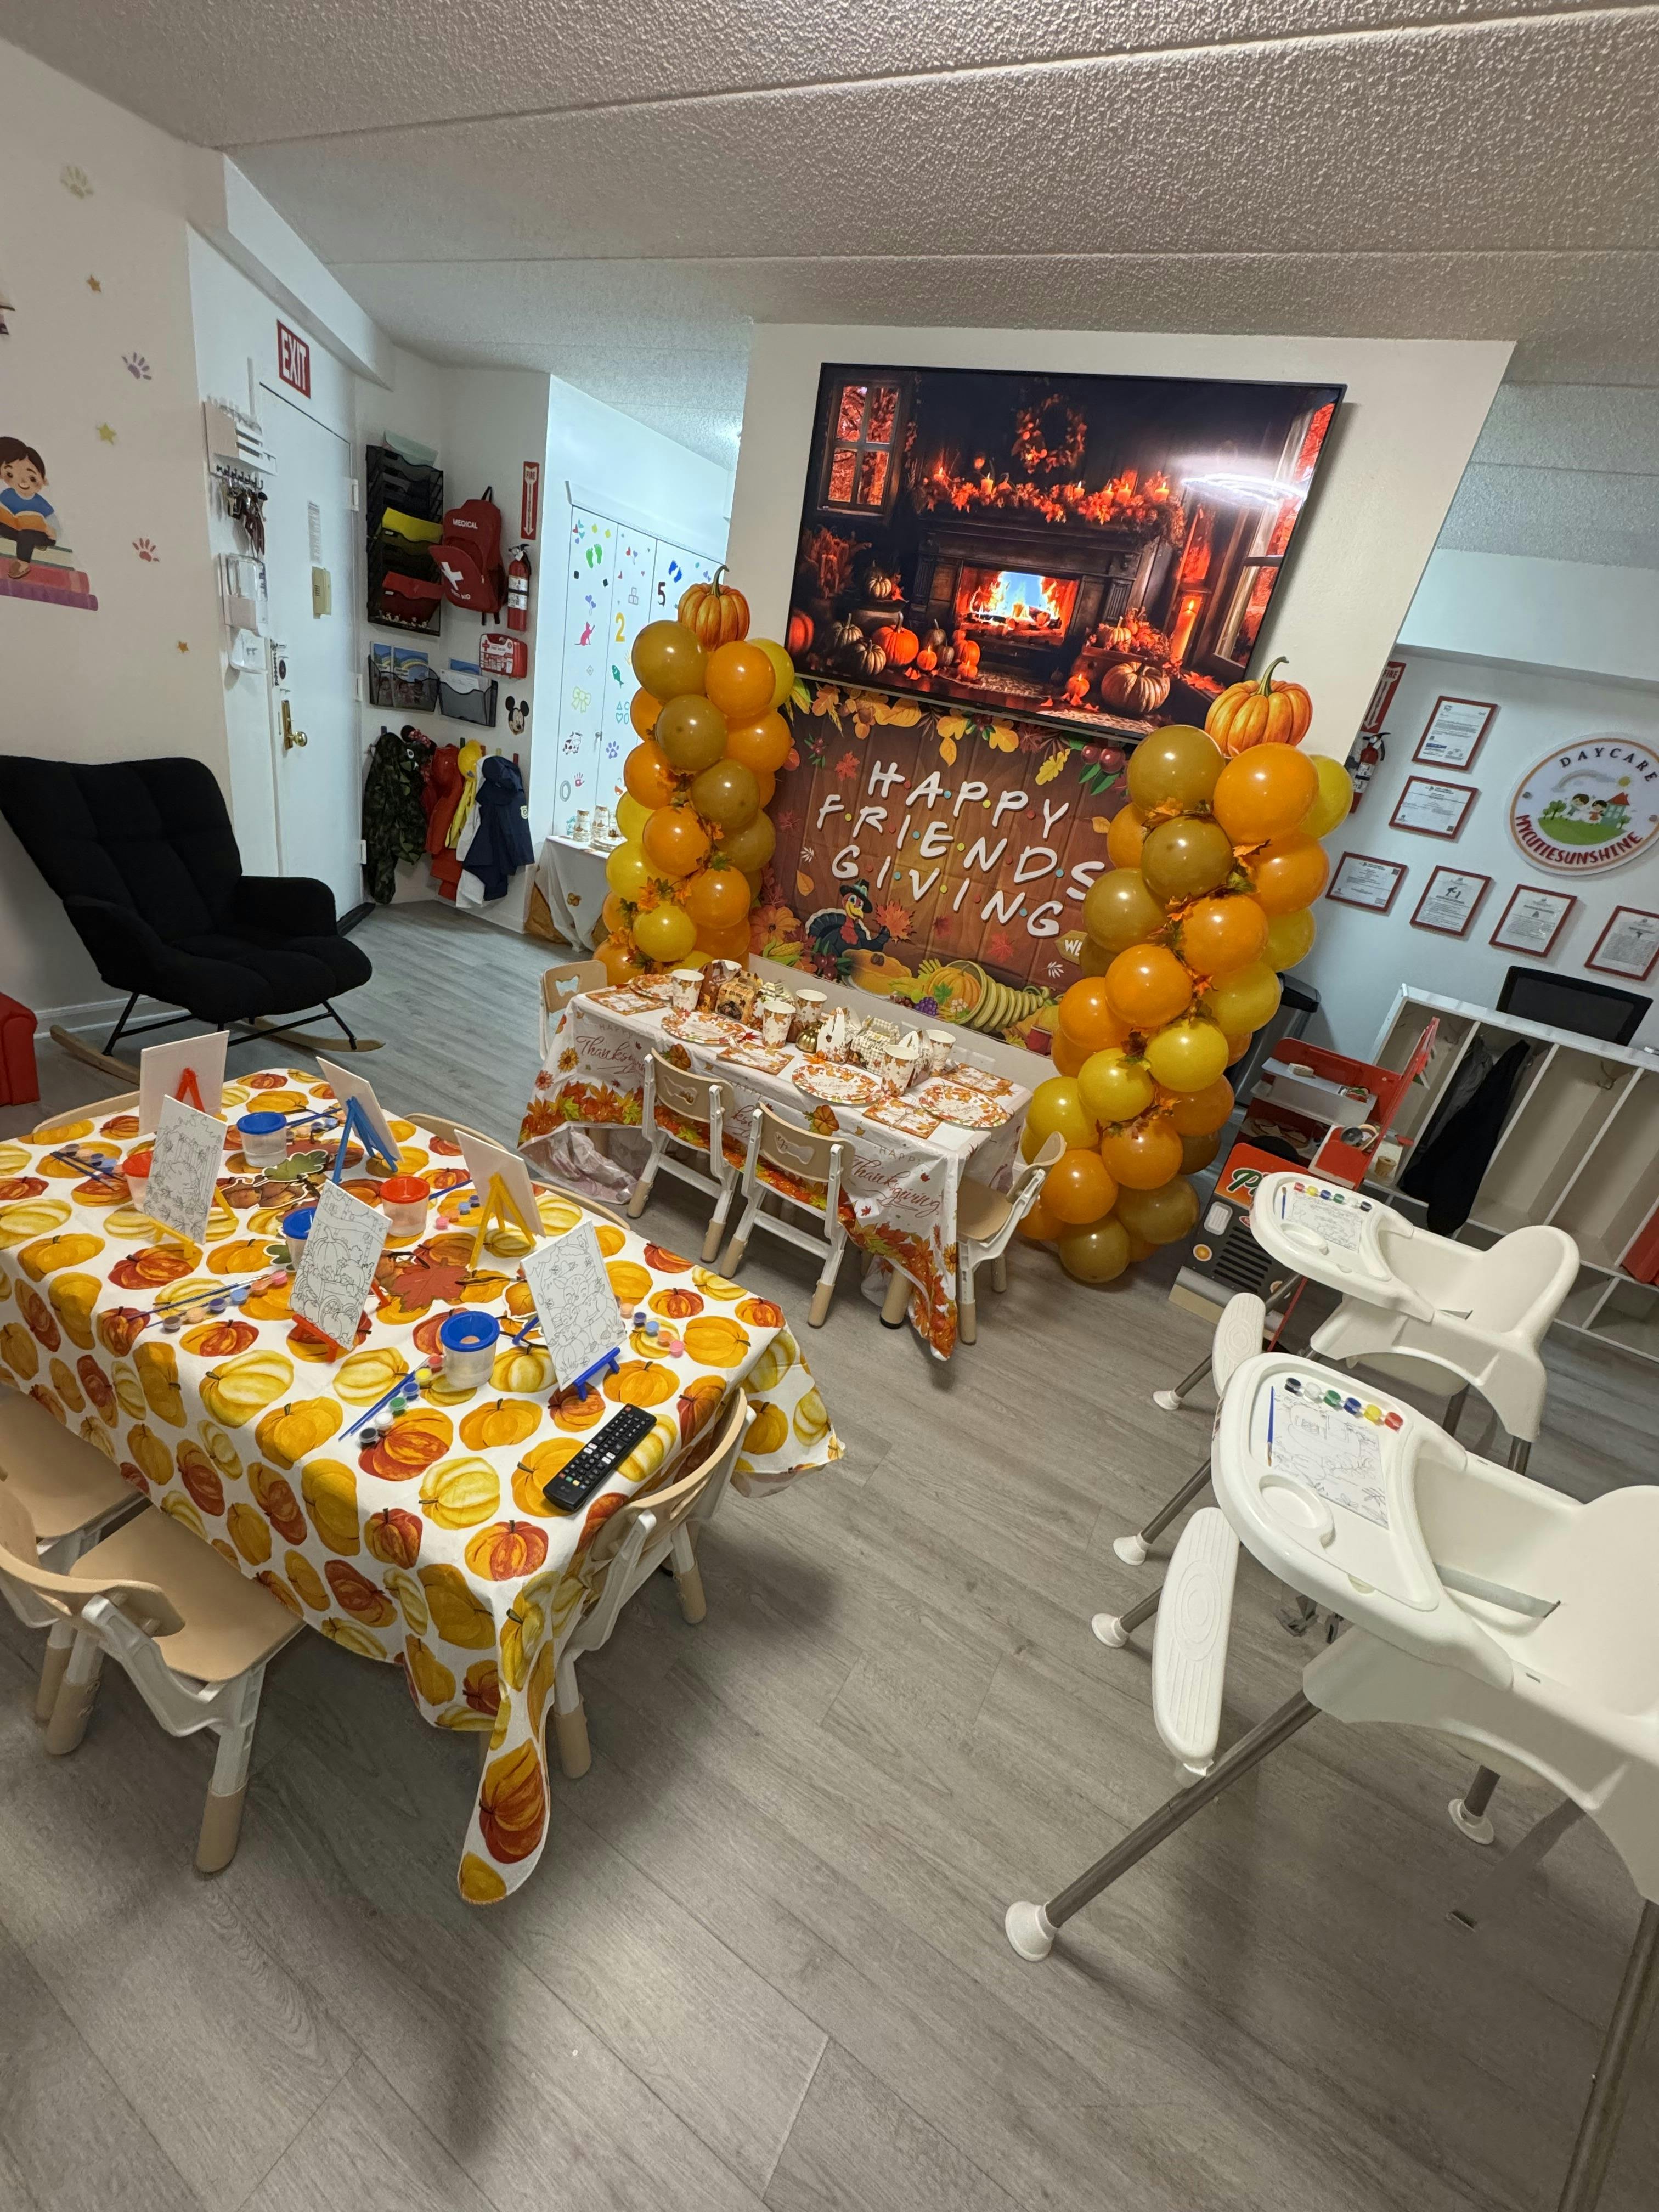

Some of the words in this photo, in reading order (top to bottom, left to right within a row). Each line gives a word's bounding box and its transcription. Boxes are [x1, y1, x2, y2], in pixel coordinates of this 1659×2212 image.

[281, 328, 306, 391] EXIT
[526, 471, 536, 480] FIRE
[453, 518, 478, 529] MEDICAL
[658, 582, 666, 607] 5
[615, 612, 625, 642] 2
[1383, 669, 1398, 679] FIRE
[1559, 747, 1657, 782] DAYCARE
[868, 760, 1069, 839] HAPPY
[816, 794, 1105, 901] FRIENDS
[1515, 814, 1643, 865] MYCUTIESUNSHINE
[831, 844, 1064, 938] GIVING
[879, 1145, 923, 1167] HAPPY
